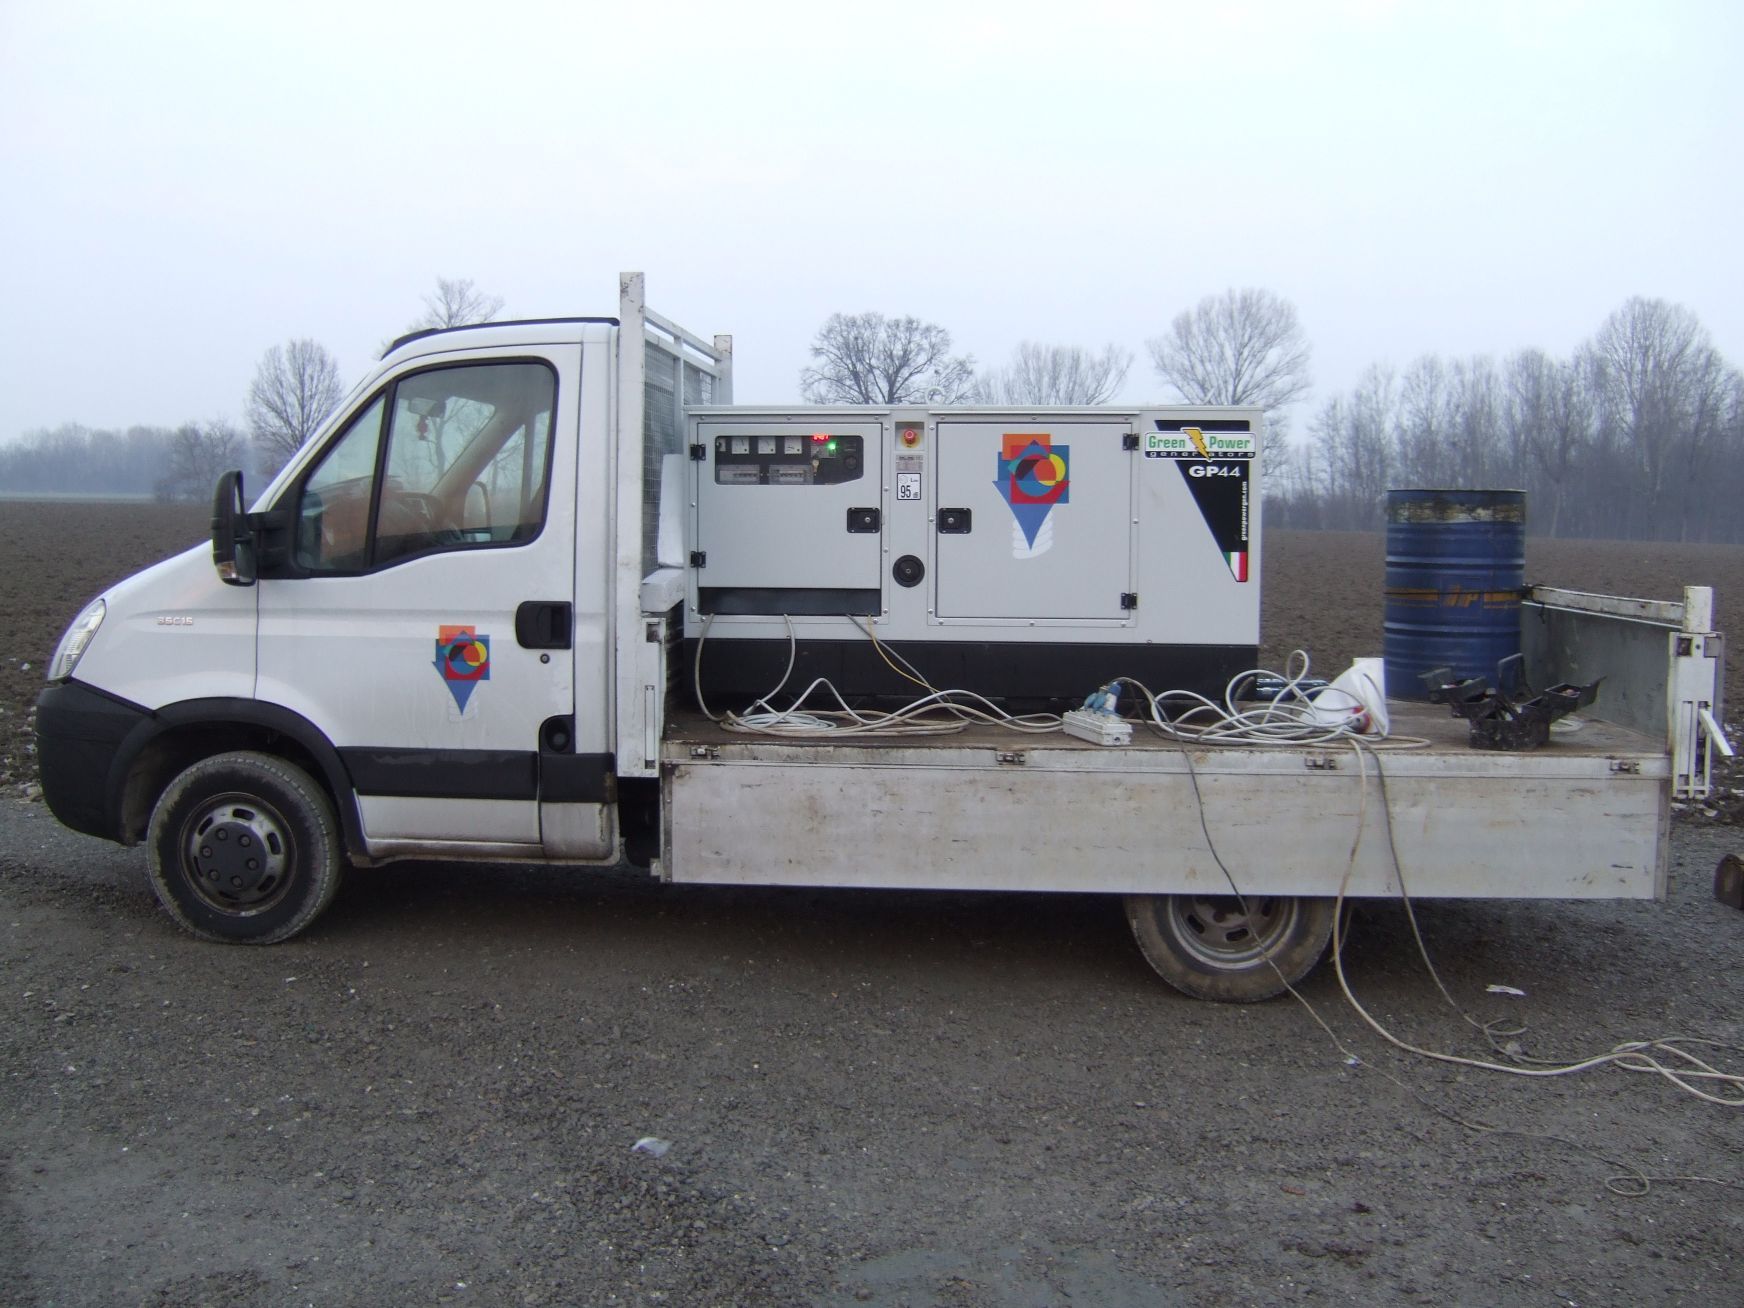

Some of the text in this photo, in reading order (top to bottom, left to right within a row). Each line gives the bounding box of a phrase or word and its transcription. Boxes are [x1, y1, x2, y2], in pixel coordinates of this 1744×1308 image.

[1148, 435, 1250, 449] Green Power
[1189, 466, 1240, 477] GP44
[900, 484, 911, 498] 95
